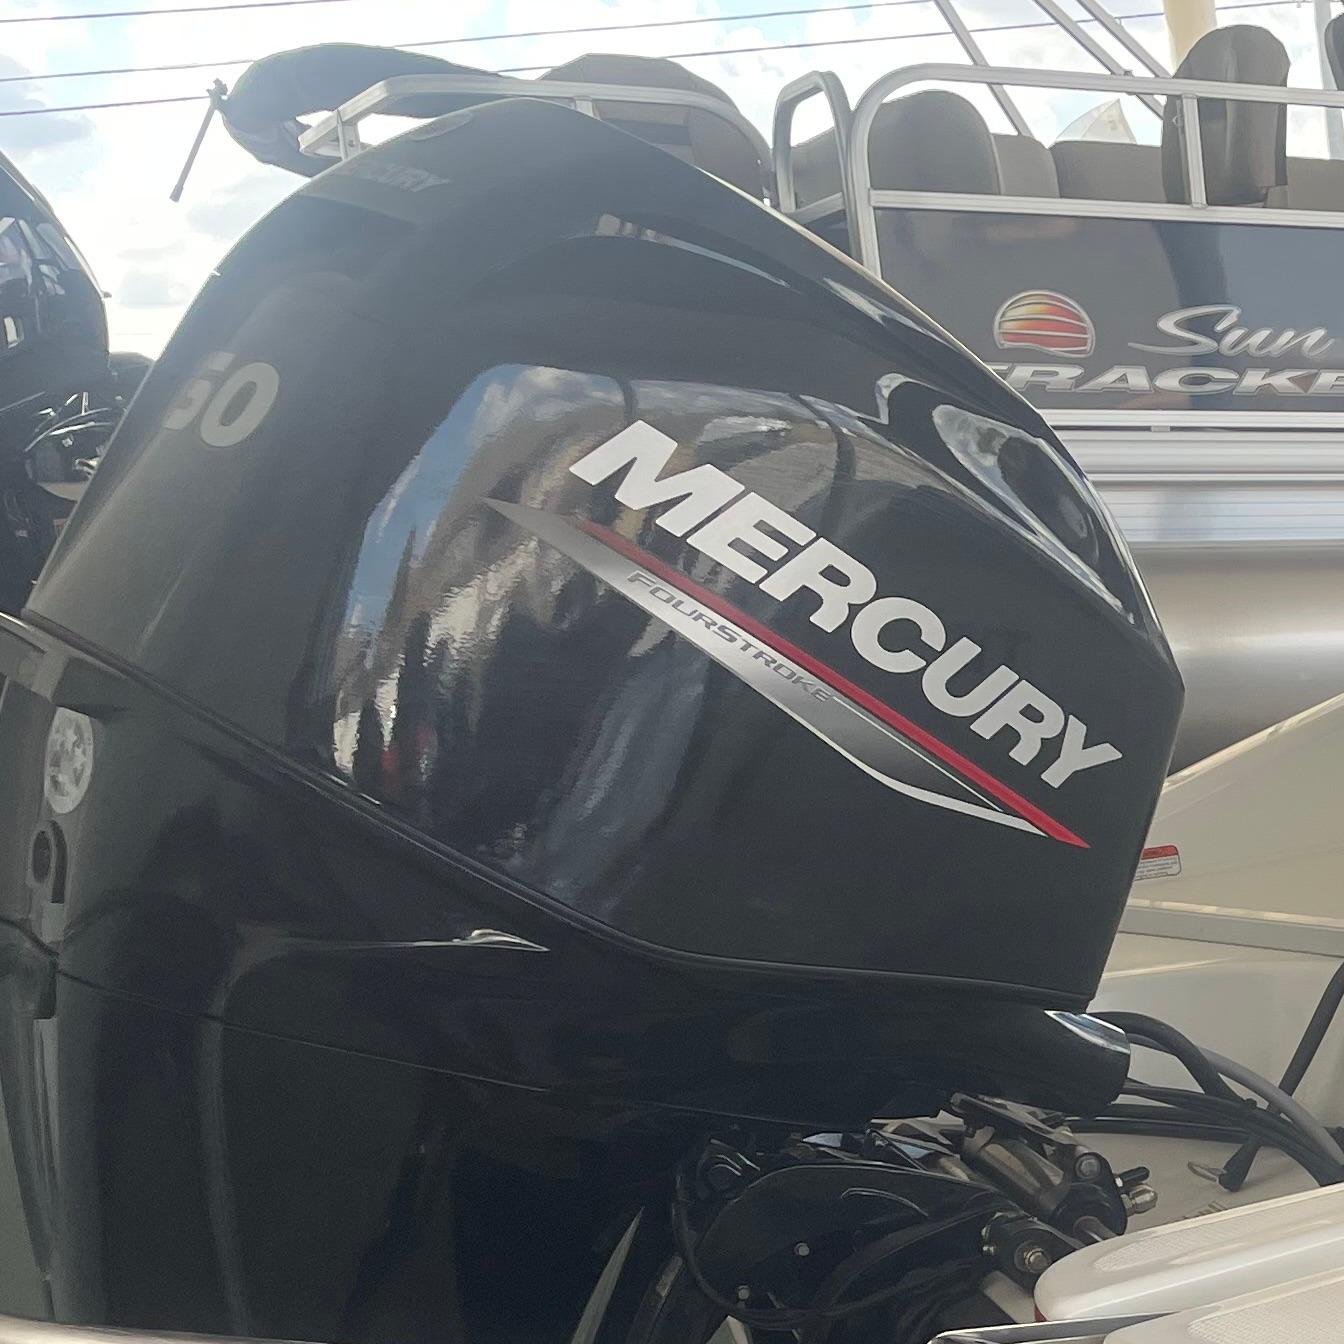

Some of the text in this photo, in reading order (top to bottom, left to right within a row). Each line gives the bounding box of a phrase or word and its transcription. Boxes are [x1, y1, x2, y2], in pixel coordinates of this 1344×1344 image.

[1127, 304, 1336, 357] Sun
[569, 419, 1122, 788] MERCURY
[627, 570, 834, 703] FOURSTROKE
